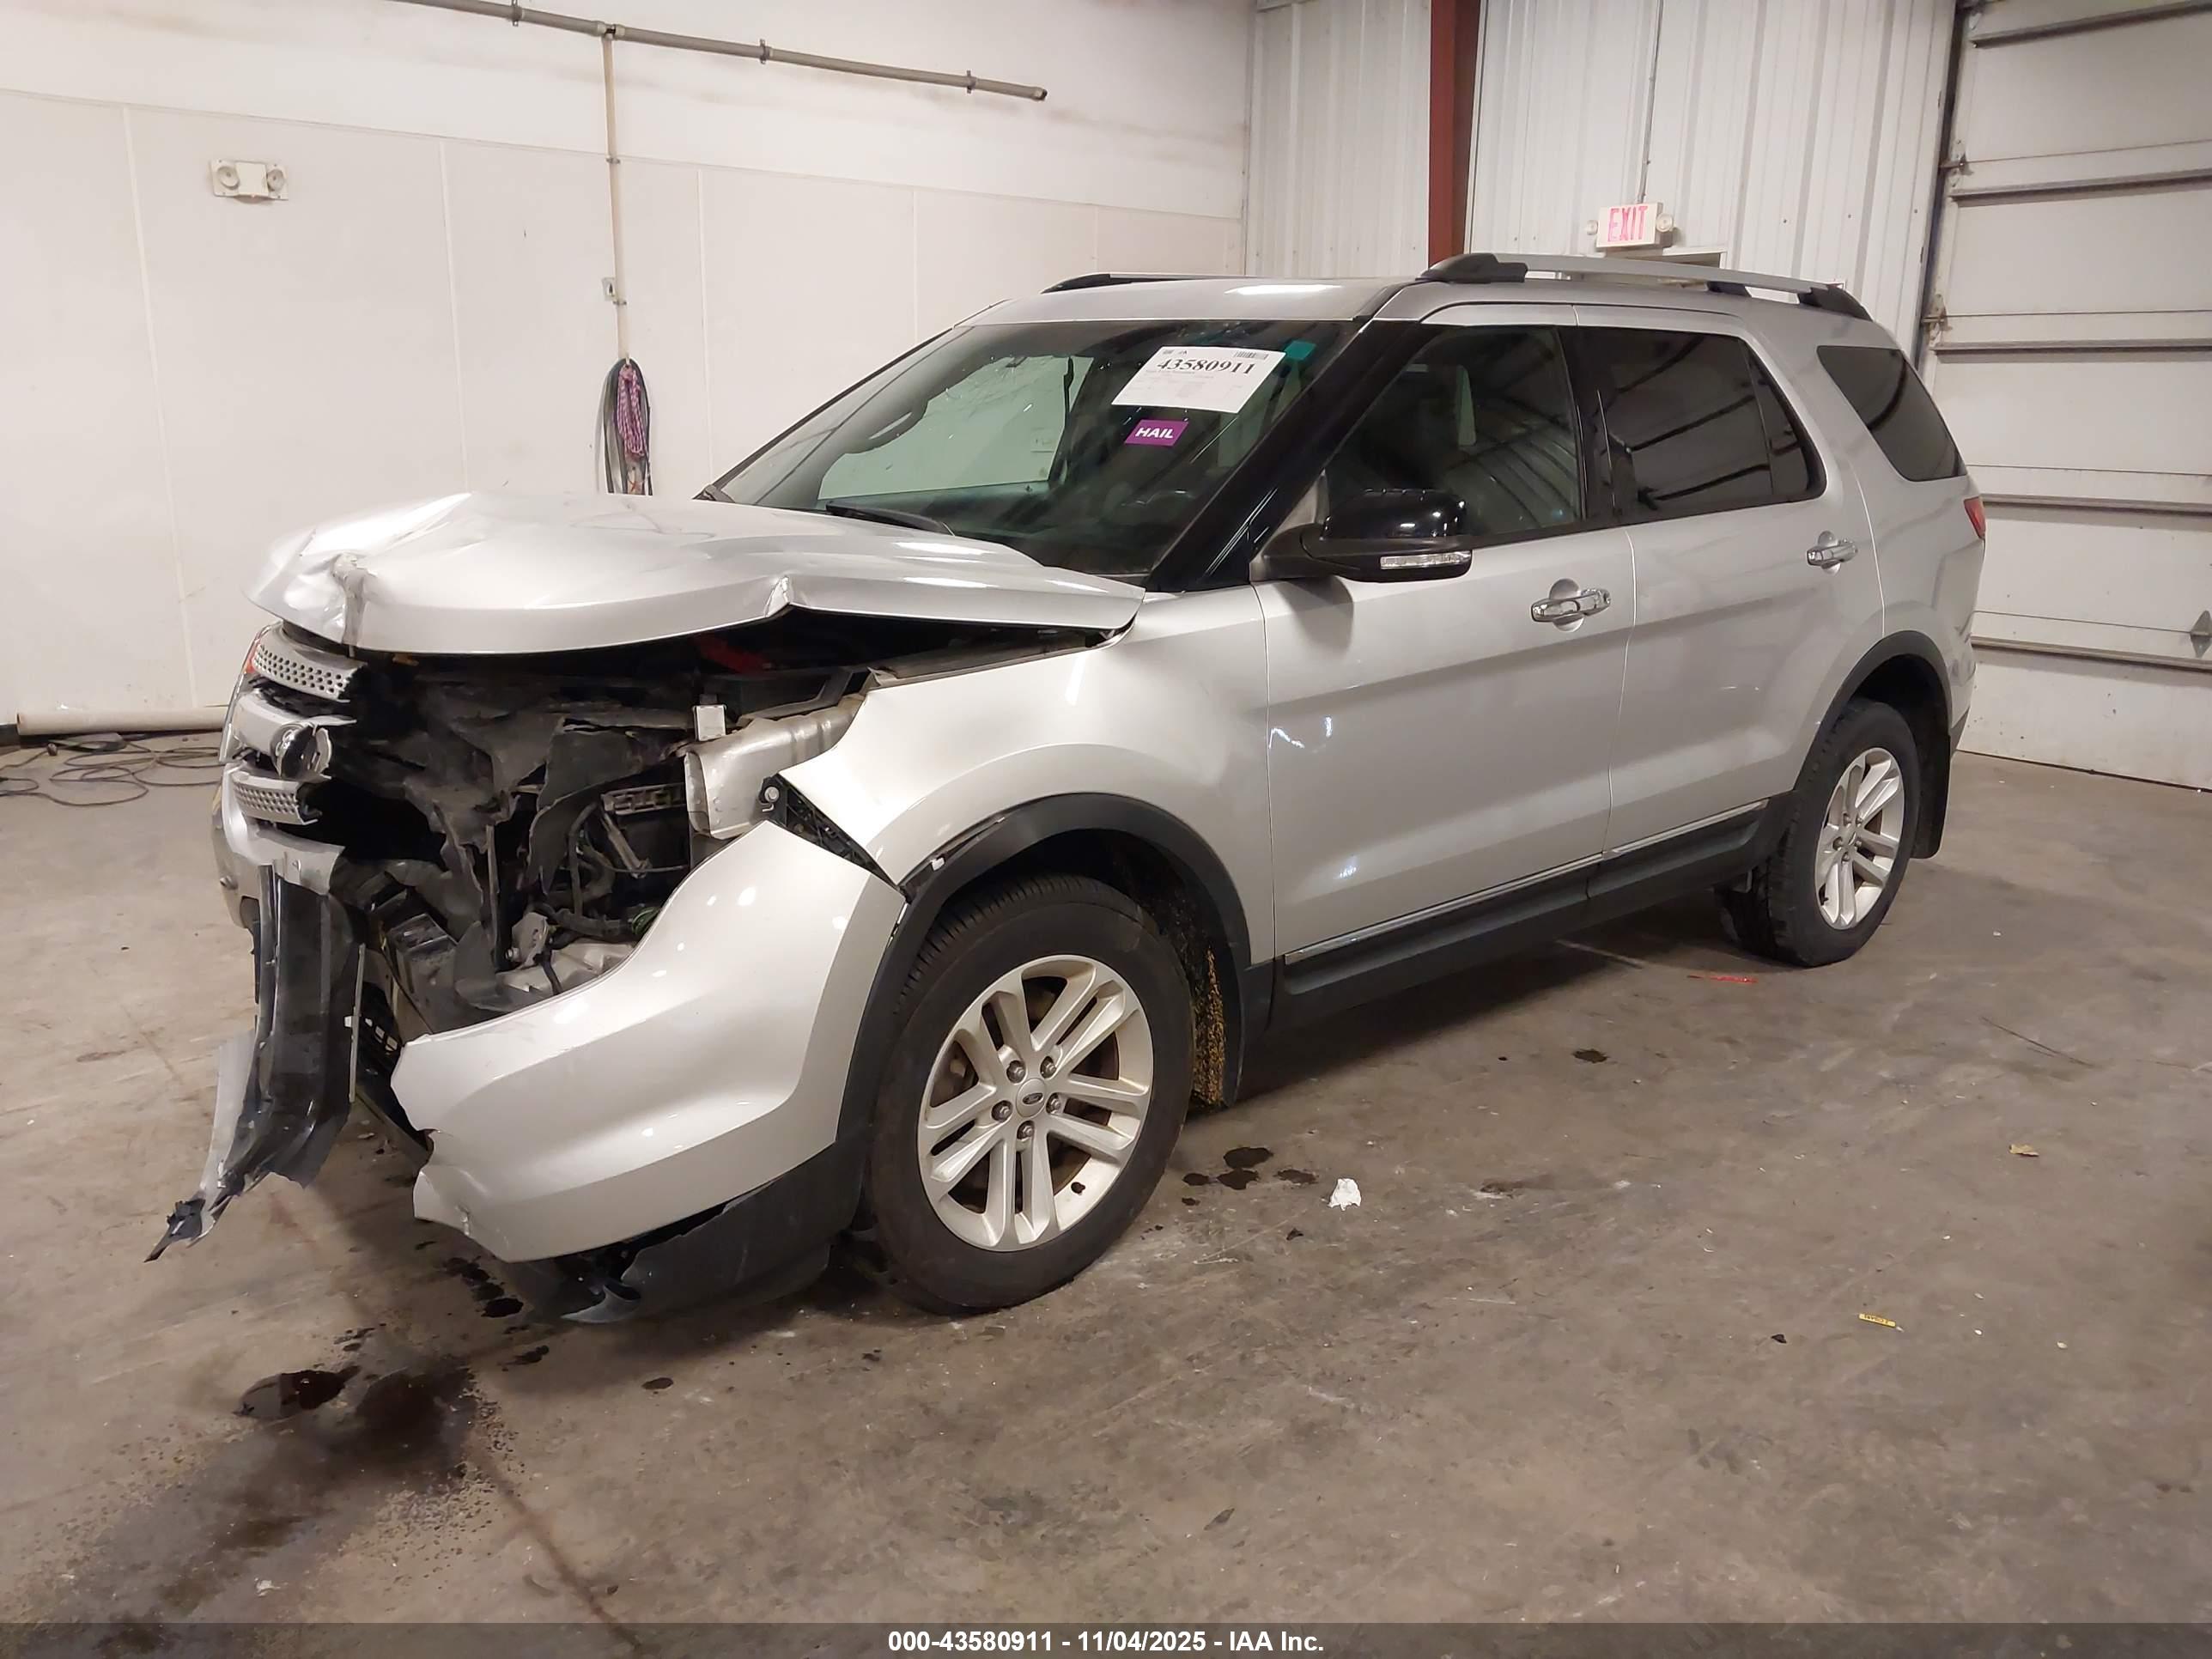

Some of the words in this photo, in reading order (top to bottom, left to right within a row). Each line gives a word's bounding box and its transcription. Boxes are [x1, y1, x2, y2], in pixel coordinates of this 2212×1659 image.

[1607, 206, 1648, 242] EXIT
[1158, 357, 1256, 375] 43580911
[1134, 428, 1174, 439] HAIL
